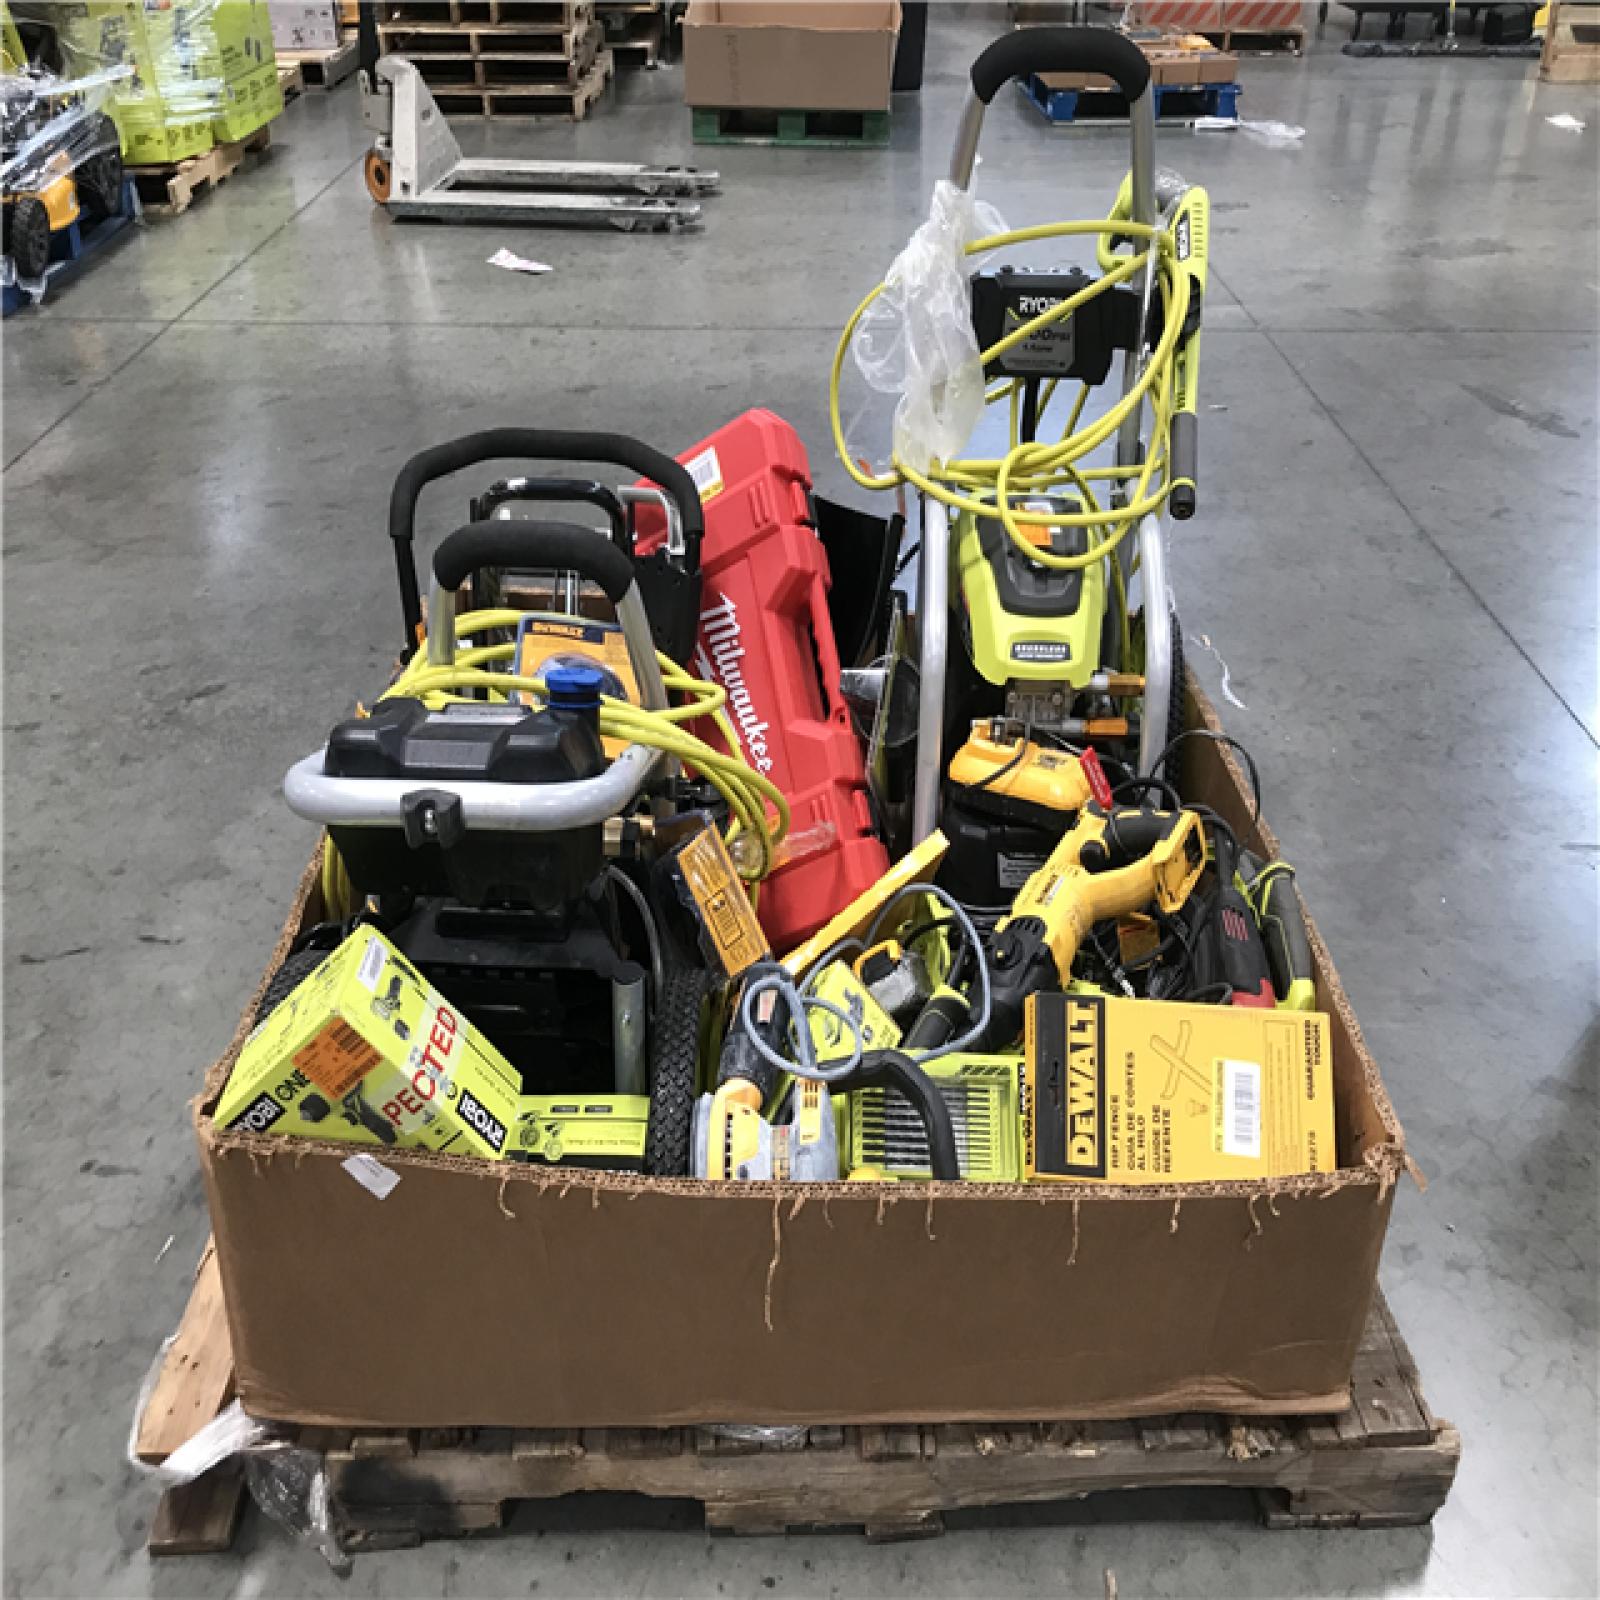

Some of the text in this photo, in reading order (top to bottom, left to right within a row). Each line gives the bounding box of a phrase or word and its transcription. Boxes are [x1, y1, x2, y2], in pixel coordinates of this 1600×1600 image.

[700, 591, 773, 777] Milwaukee
[382, 1005, 459, 1127] PECTED
[1068, 1001, 1097, 1164] DEWALT
[1125, 1051, 1135, 1108] CORTES
[1111, 1094, 1120, 1168] RIP FENCE
[1126, 1112, 1135, 1131] DE
[1152, 1105, 1161, 1173] GUIDE DE
[1162, 1109, 1171, 1173] REFENTE
[1137, 1152, 1146, 1171] AL
